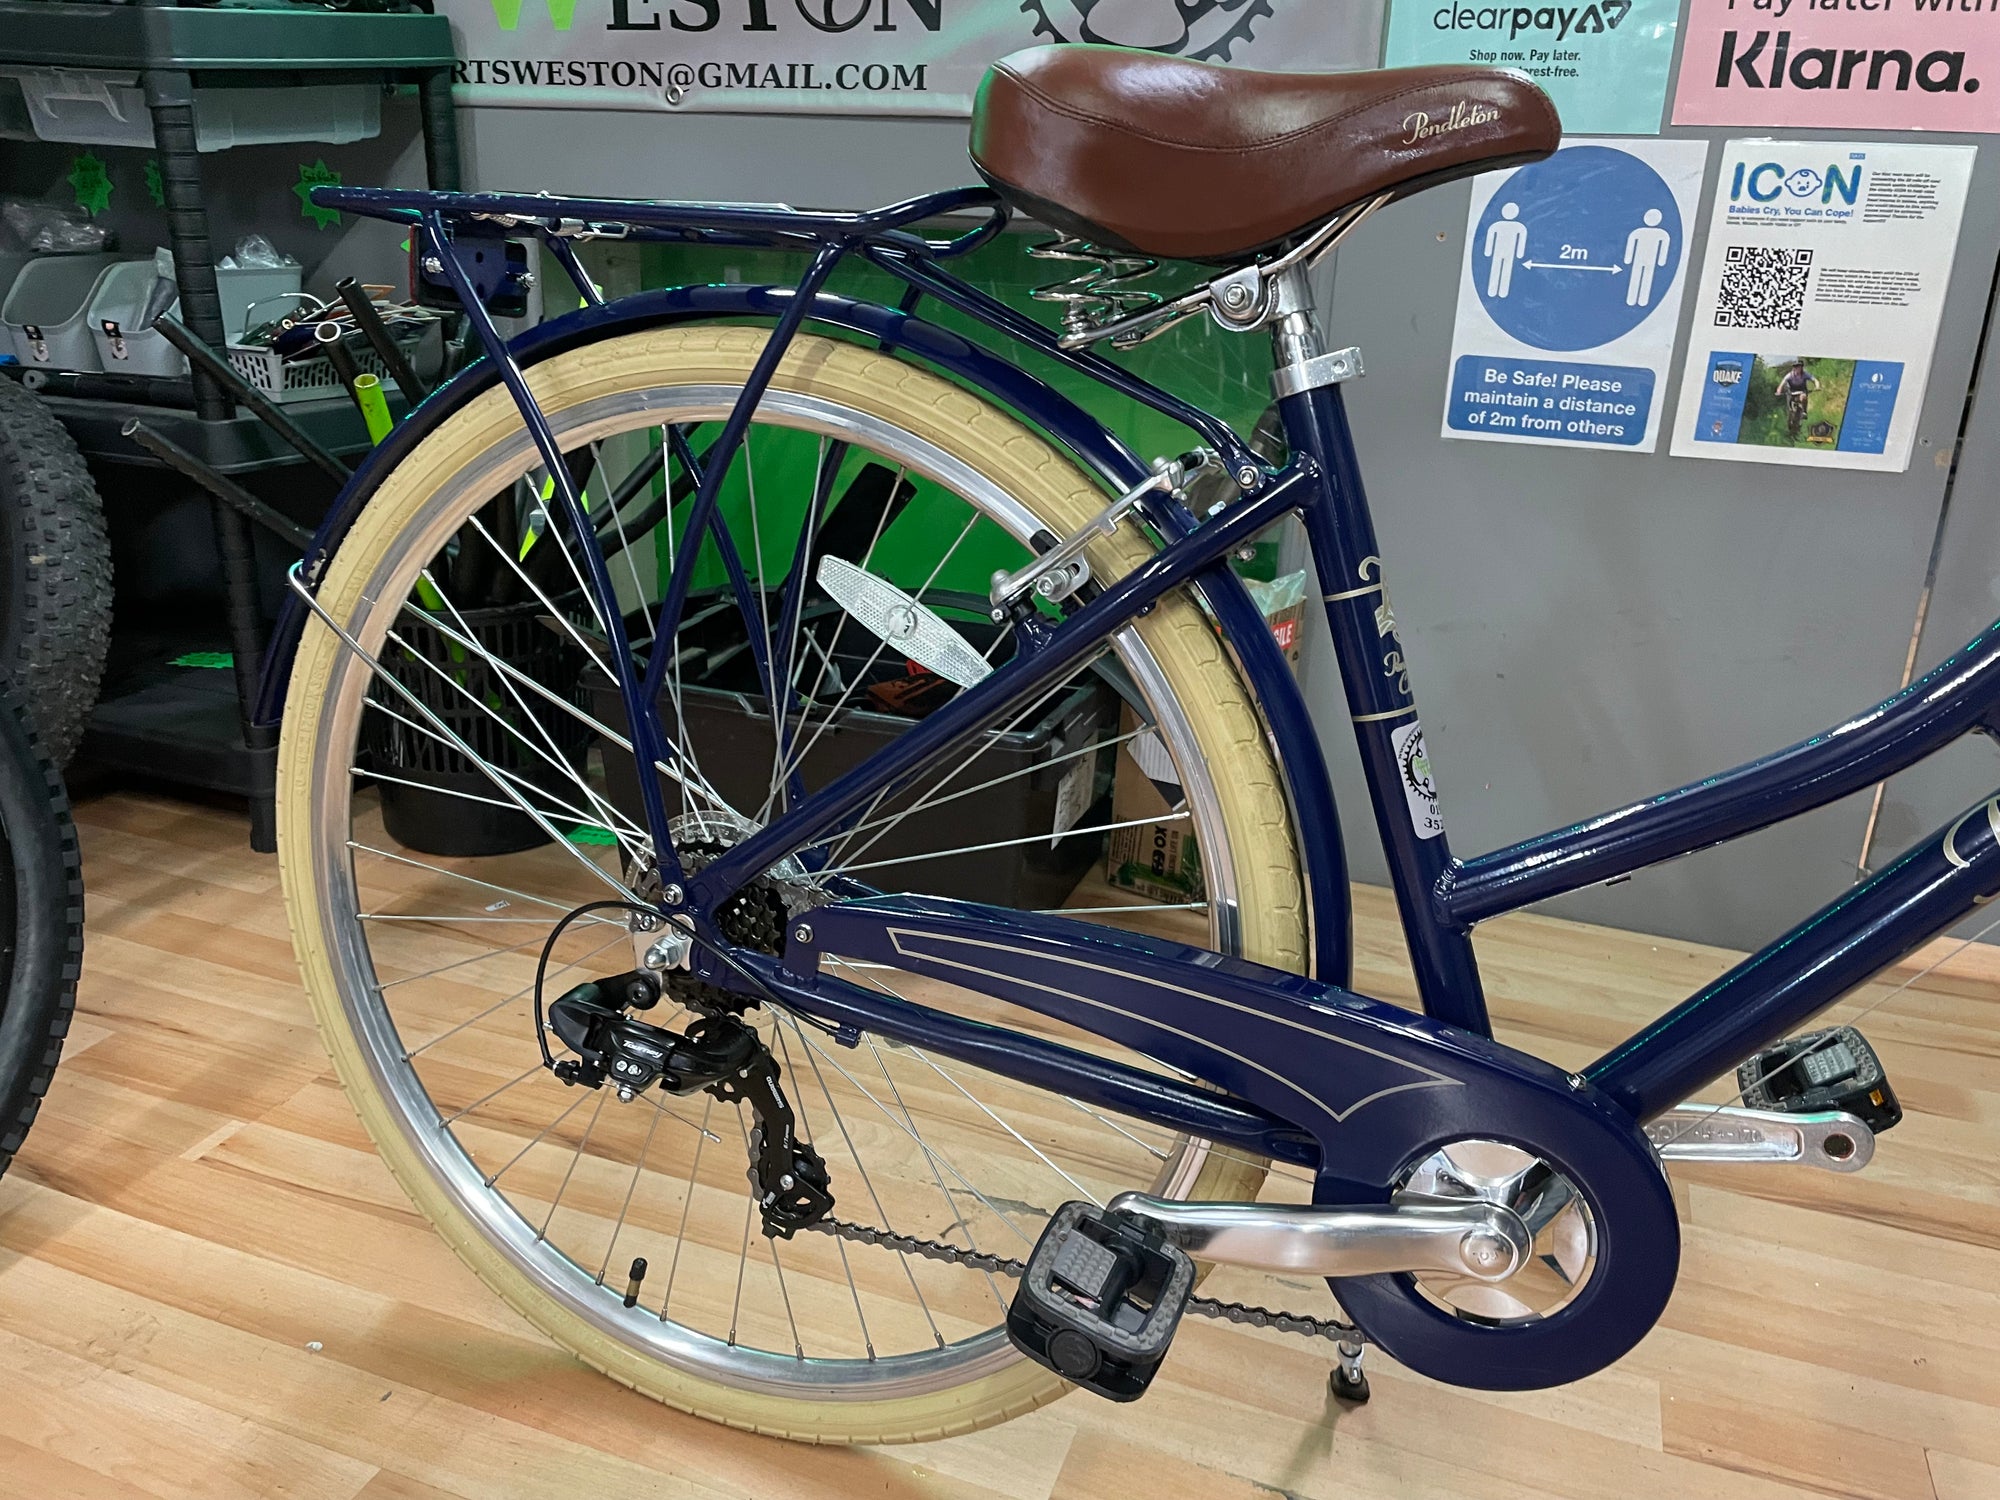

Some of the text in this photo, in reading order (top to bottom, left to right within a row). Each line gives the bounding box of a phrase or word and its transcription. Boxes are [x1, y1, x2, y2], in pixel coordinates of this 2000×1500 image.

[1433, 0, 1578, 41] clearpay
[1469, 49, 1582, 64] Shop now. Pay later.
[1715, 30, 1980, 93] Klarna.
[1402, 100, 1501, 145] Pendleton
[1728, 205, 1761, 215] Babies
[1784, 206, 1802, 217] You
[1804, 208, 1823, 217] Can
[1826, 208, 1854, 219] Cope!
[1559, 244, 1588, 260] 2m
[1484, 368, 1622, 393] Be Safe! Please
[1713, 369, 1743, 385] QUAKE
[1464, 390, 1636, 416] maintain a distance
[1468, 411, 1624, 437] of 2m from others
[622, 1039, 664, 1059] Tourney
